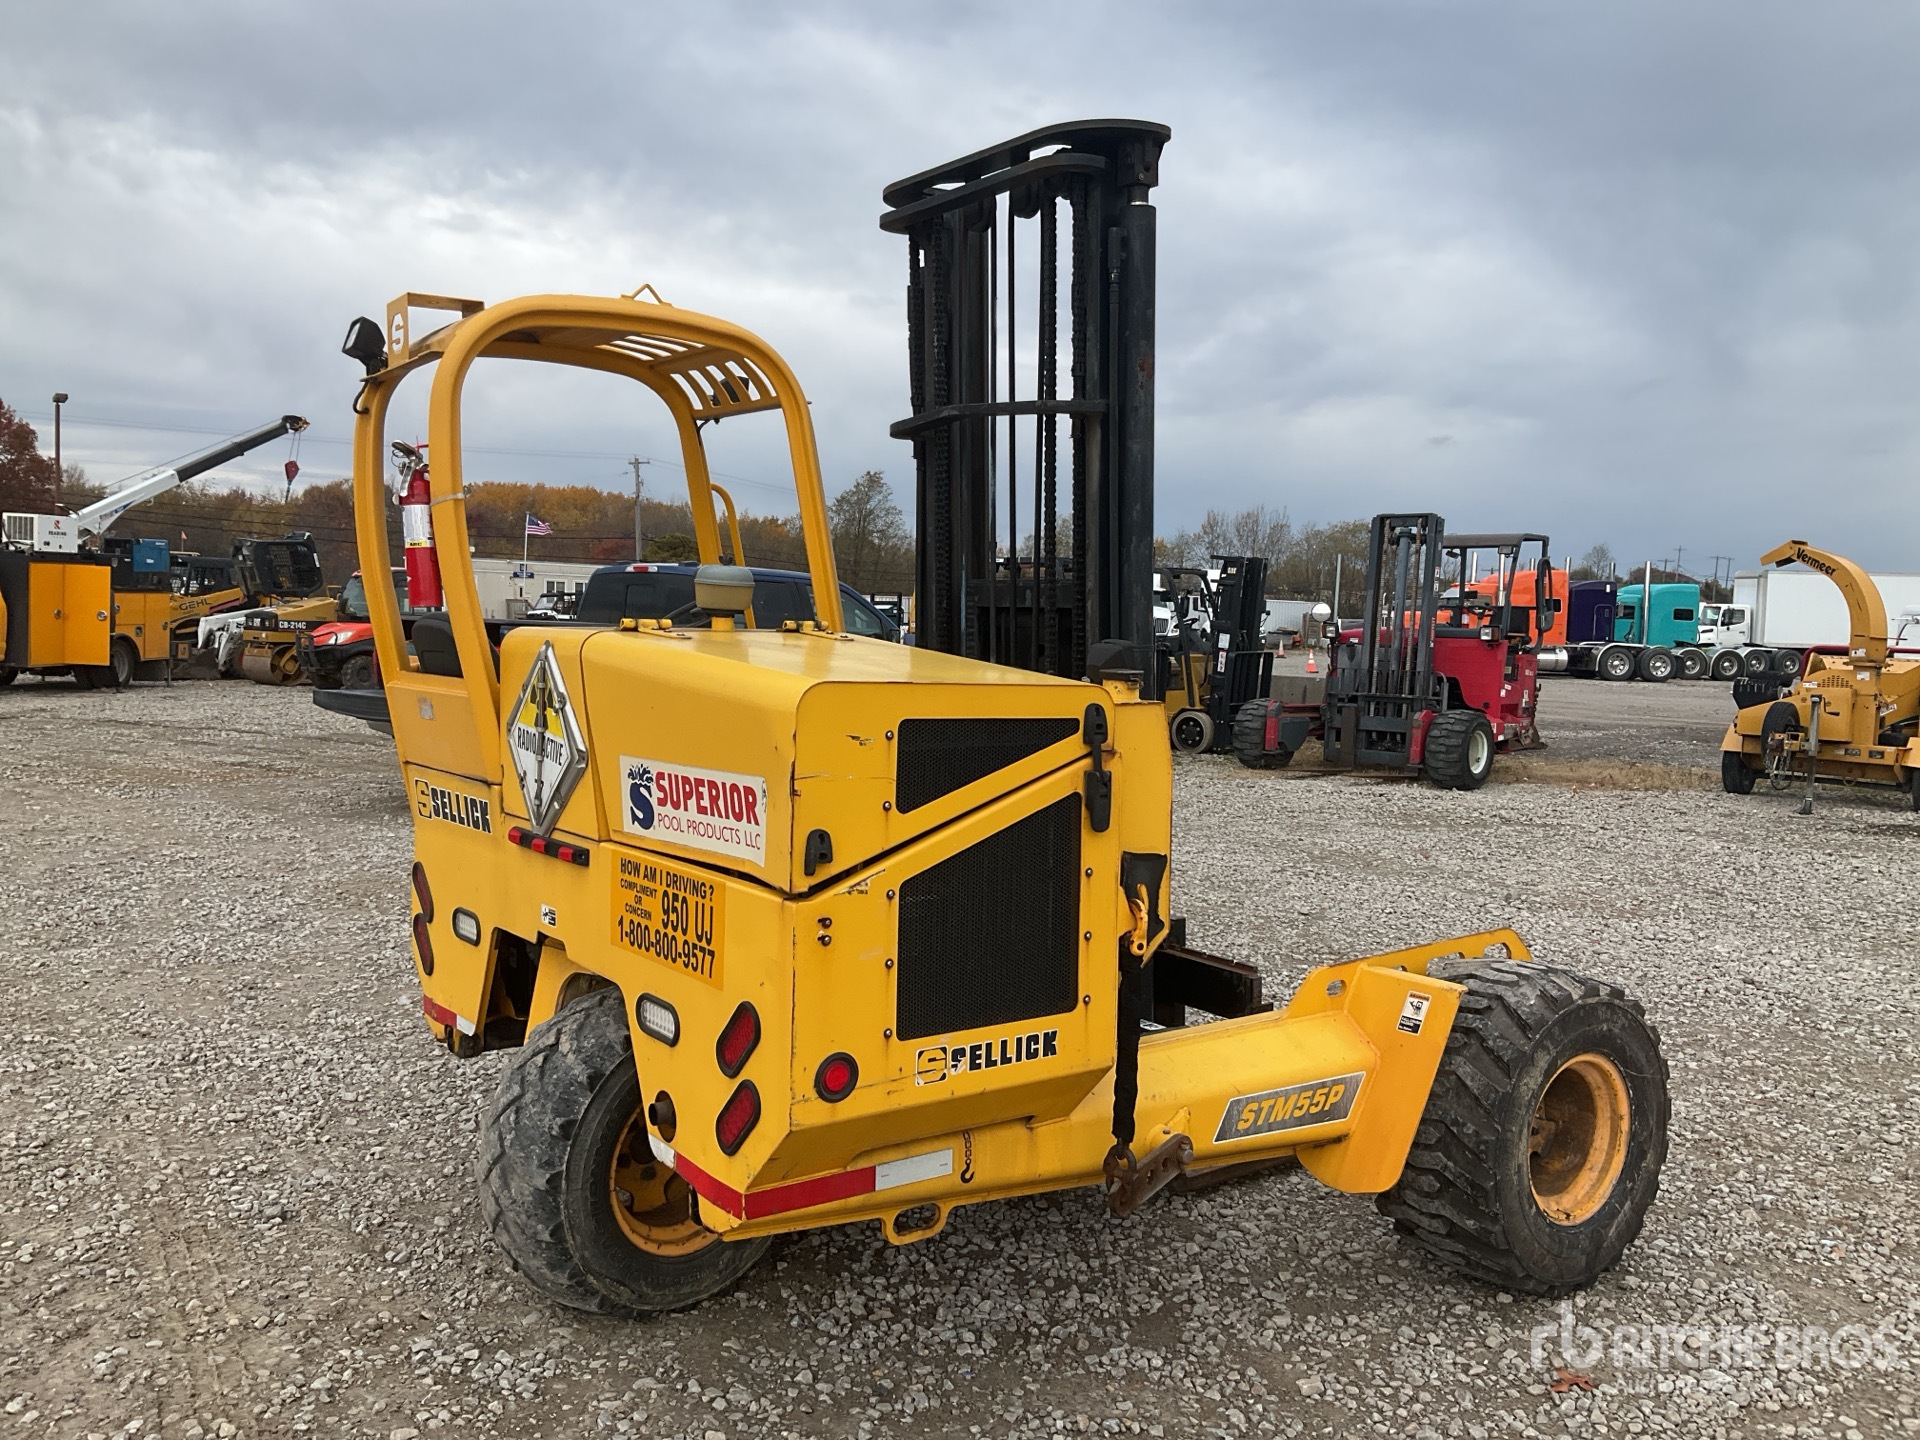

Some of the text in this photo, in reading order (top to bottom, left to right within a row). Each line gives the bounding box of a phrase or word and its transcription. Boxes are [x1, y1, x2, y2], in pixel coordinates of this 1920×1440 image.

[1796, 547, 1836, 576] Vermeer
[178, 598, 213, 611] GEHL
[279, 620, 307, 629] CB-214C
[431, 787, 492, 833] SELLICK
[655, 771, 760, 827] SUPERIOR
[657, 812, 761, 850] POOL PRODUCTS LLC
[620, 857, 641, 878] HOW
[643, 865, 657, 884] AM
[659, 869, 663, 886] I
[620, 878, 657, 899] COMPLIMENT
[634, 894, 643, 906] OR
[625, 902, 652, 921] CONCERN
[661, 889, 713, 947] 950 UJ
[617, 914, 715, 979] 1-800-800-9577
[950, 1030, 1058, 1073] SELLICK
[1236, 1084, 1345, 1131] STM55P
